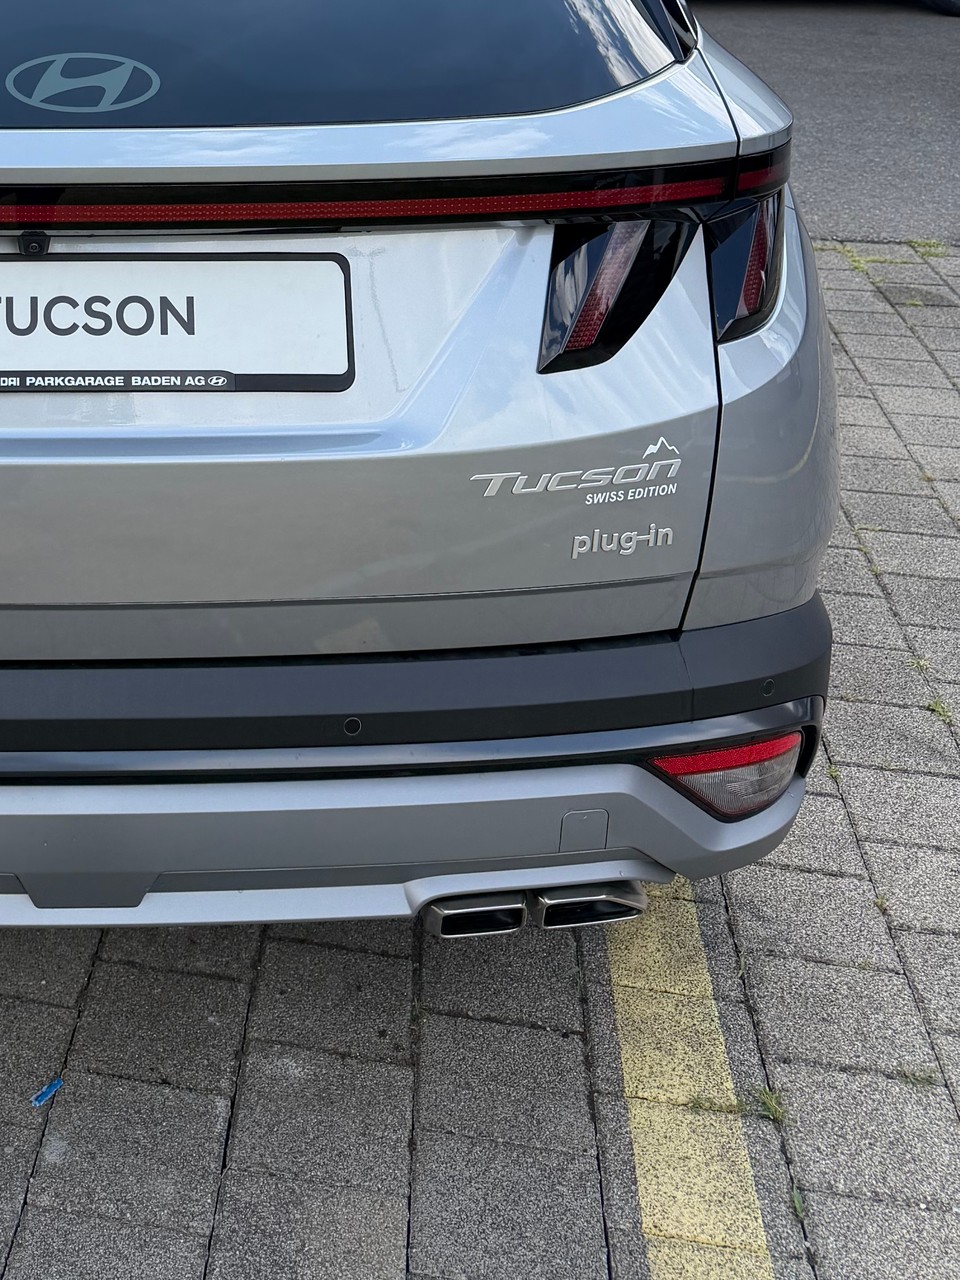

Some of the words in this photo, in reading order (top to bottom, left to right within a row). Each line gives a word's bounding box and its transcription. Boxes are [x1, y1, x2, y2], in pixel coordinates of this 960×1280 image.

[26, 376, 124, 387] PARKGARAGE
[131, 376, 180, 386] BADEN
[185, 376, 206, 386] AG
[585, 490, 624, 505] SWISS
[627, 483, 678, 501] EDITION
[571, 523, 674, 559] plug-in
